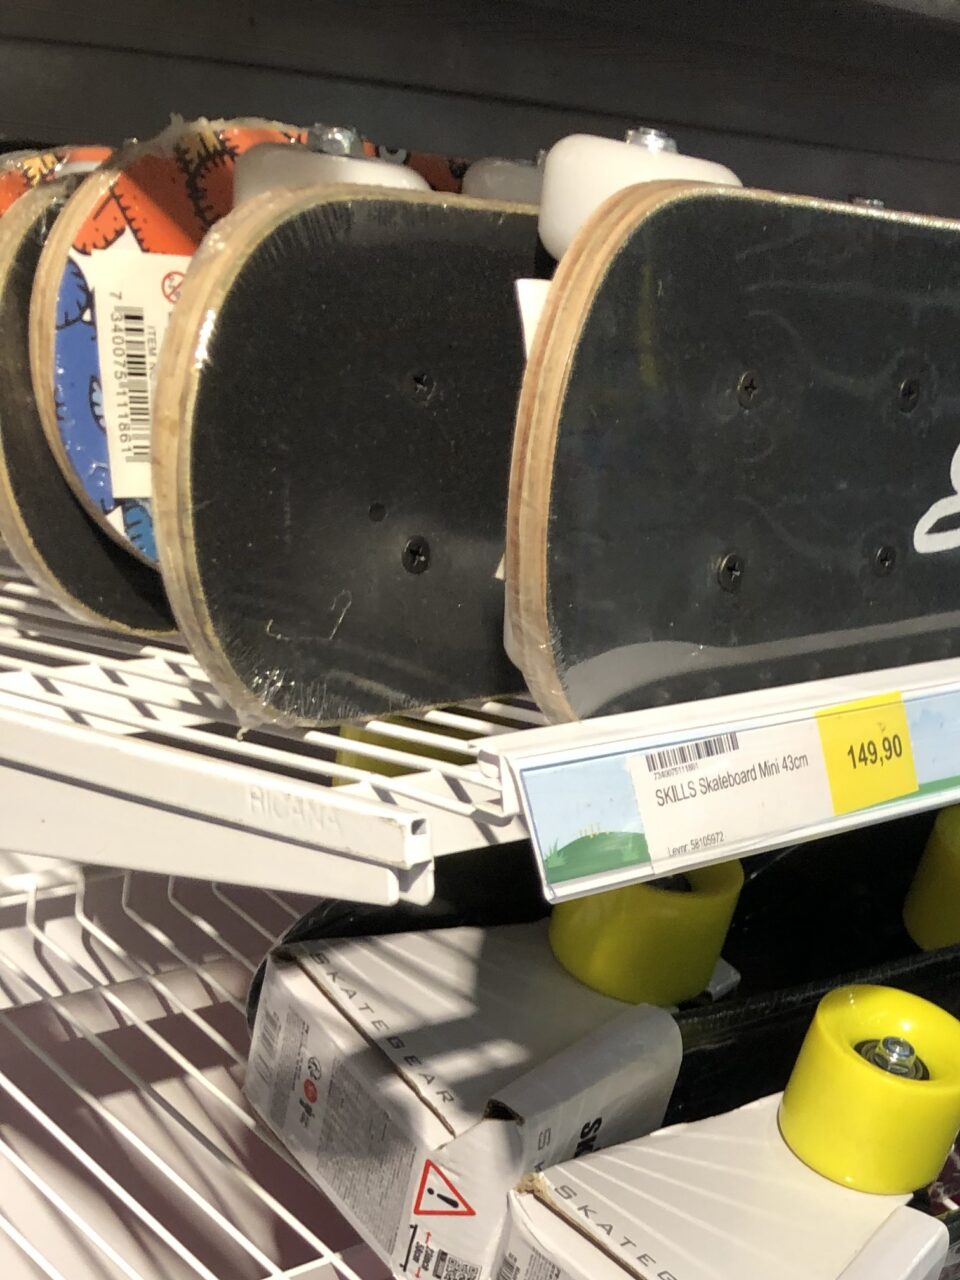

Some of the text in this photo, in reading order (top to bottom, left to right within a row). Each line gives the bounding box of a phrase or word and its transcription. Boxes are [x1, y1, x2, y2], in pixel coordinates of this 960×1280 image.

[846, 733, 903, 771] 149,90
[655, 753, 809, 807] SKILLS Skateboard Mini 43cm
[309, 951, 457, 1105] SKATEGEAR
